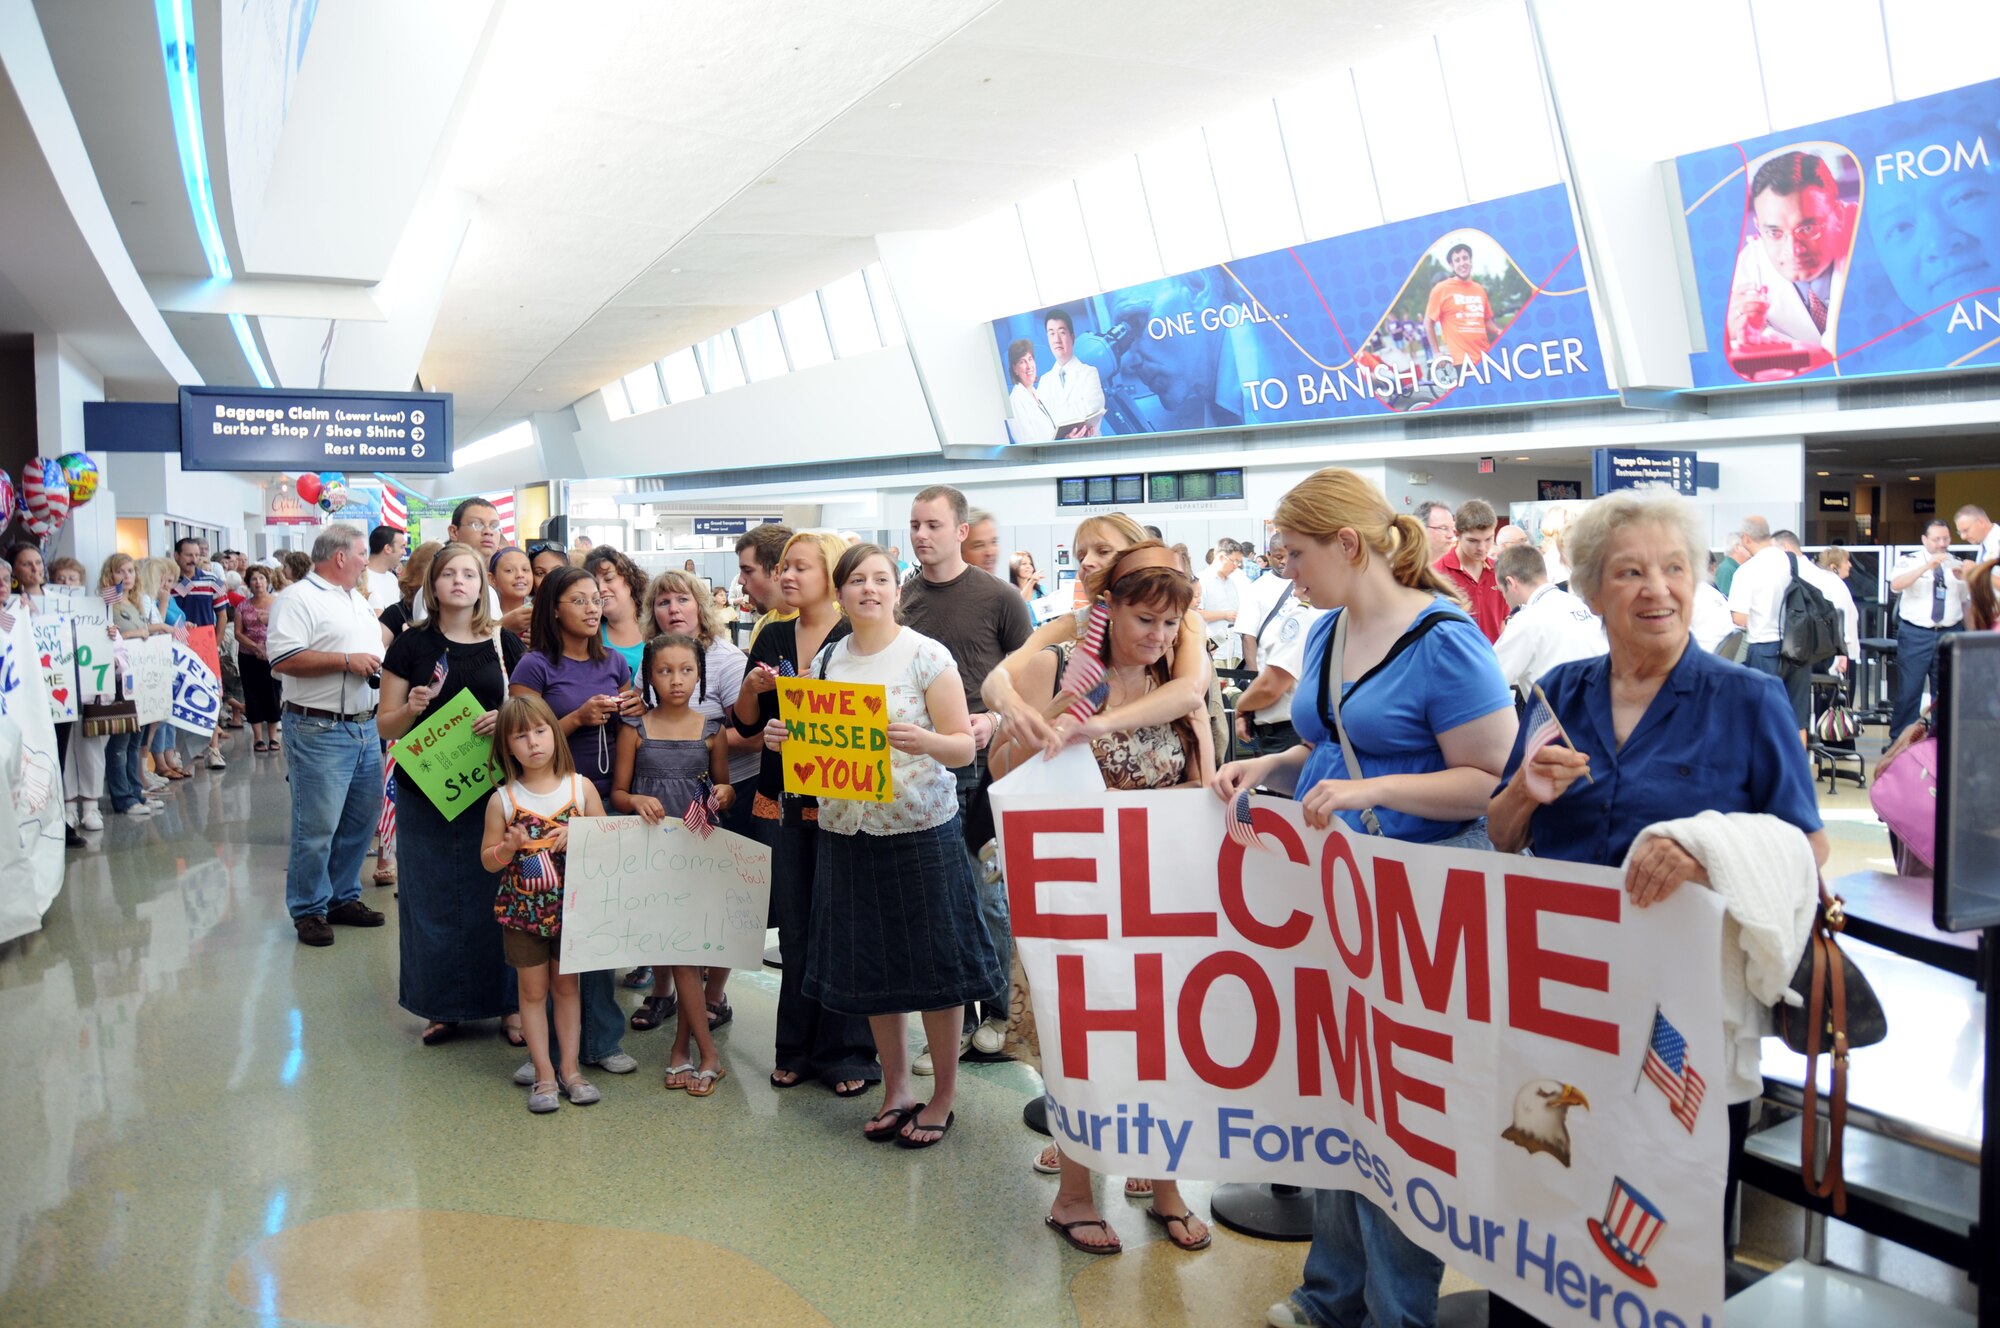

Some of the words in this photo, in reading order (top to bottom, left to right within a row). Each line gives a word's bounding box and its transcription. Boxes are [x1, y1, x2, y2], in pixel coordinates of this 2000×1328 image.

[1875, 136, 1990, 185] FROM
[1148, 312, 1196, 340] ONE
[1201, 301, 1288, 331] GOAL...
[1243, 378, 1288, 411] TO
[1298, 361, 1419, 406] BANISH
[1431, 338, 1589, 390] CANCER
[212, 422, 266, 435] Barber
[271, 423, 308, 438] Shop
[325, 425, 361, 437] Shoe
[366, 425, 405, 438] Shine
[215, 405, 284, 421] Baggage
[288, 407, 330, 420] Claim
[335, 410, 371, 422] (Lower
[374, 411, 405, 423] Level)
[324, 443, 355, 455] Rest
[359, 444, 406, 456] Rooms
[807, 690, 856, 715] WE
[406, 706, 472, 756] Welcome
[785, 719, 886, 751] MISSED
[814, 755, 886, 801] YOU!
[595, 818, 641, 833] Vanessa
[583, 829, 733, 879] Welcome
[600, 877, 691, 918] Home
[1056, 950, 1457, 1178] HOME
[1217, 1106, 1398, 1211] Forces,
[1406, 1177, 1505, 1263] Our
